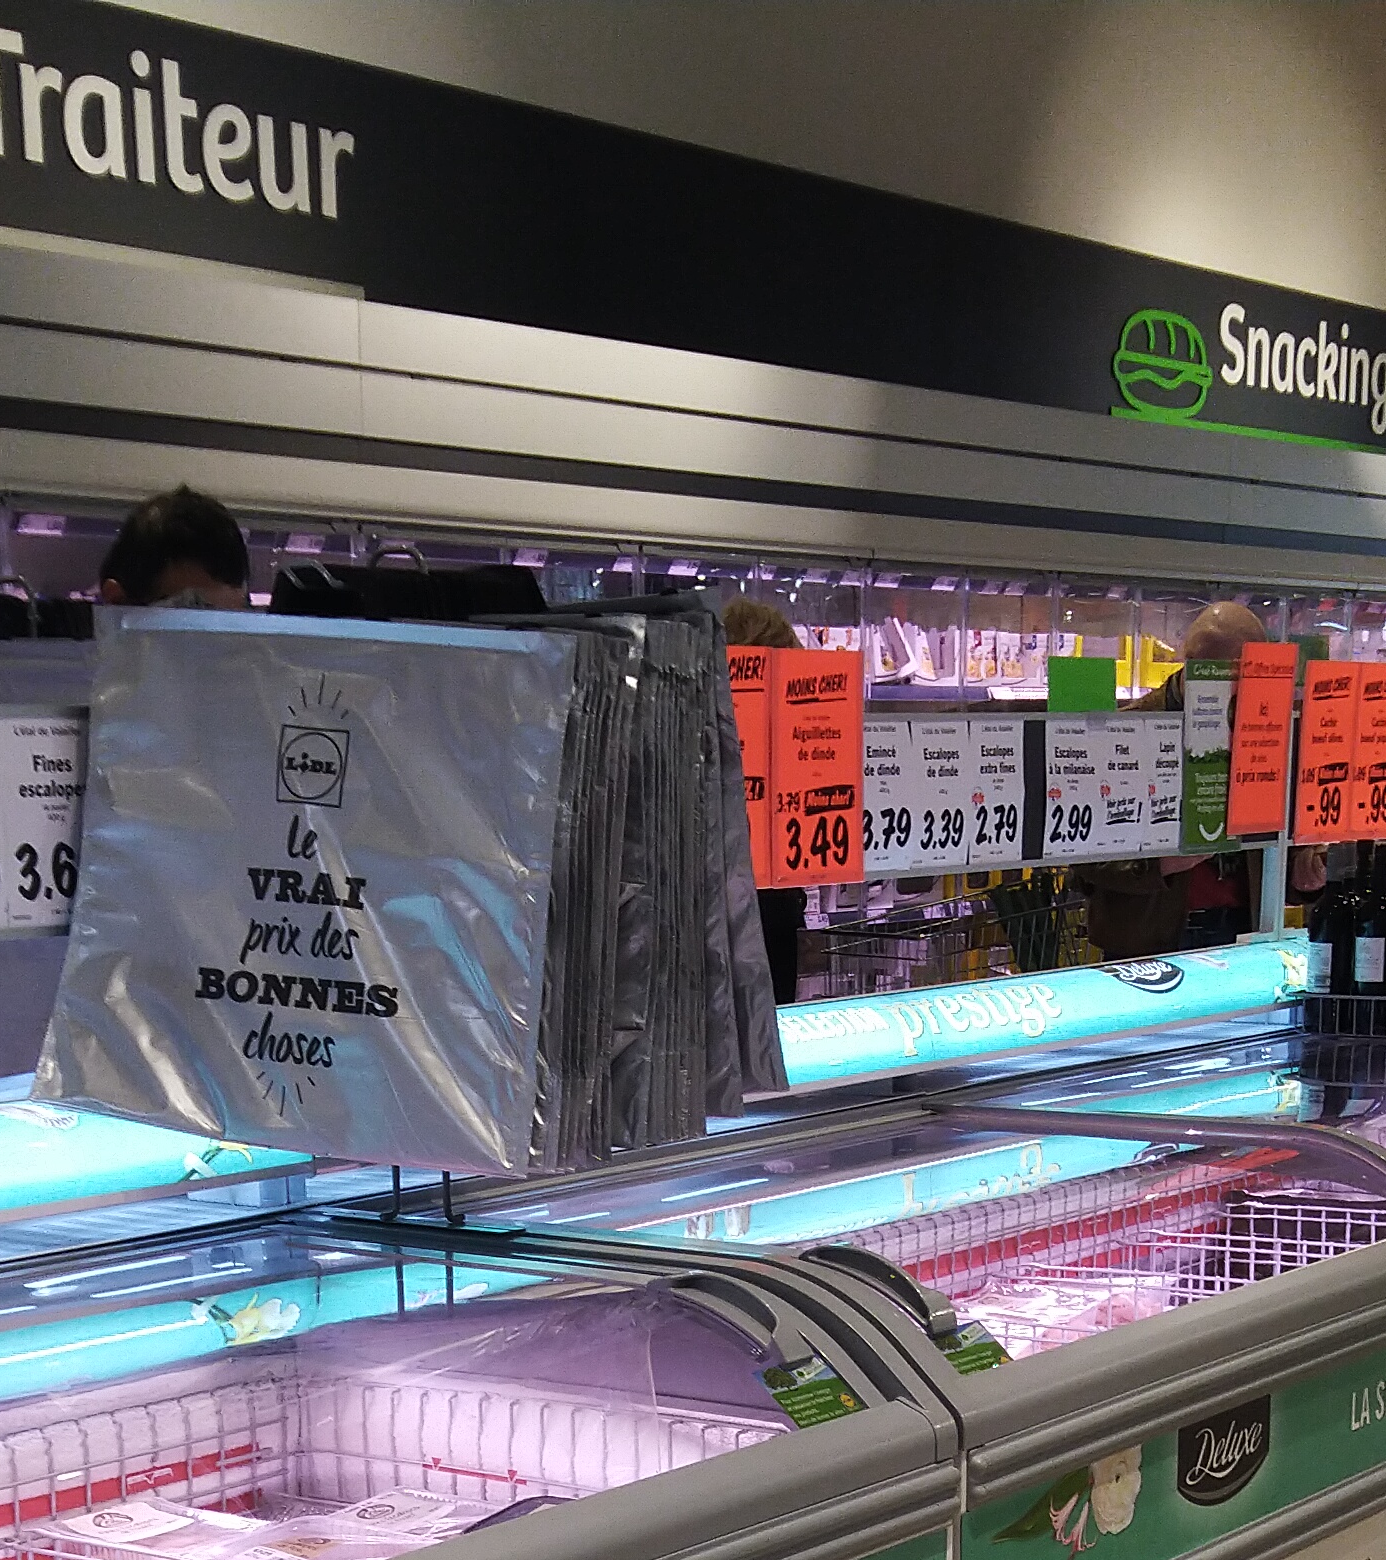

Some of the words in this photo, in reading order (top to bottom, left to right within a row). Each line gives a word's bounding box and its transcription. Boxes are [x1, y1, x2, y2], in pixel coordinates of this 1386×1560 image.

[792, 726, 842, 743] Aiguillettes
[923, 747, 960, 763] Escalopes
[981, 745, 1014, 760] Escalopes
[32, 754, 73, 773] Fines
[863, 763, 874, 776] de
[927, 766, 936, 777] de
[18, 779, 86, 800] escalope
[786, 815, 849, 871] 3.49
[863, 806, 912, 851] 3.79
[920, 808, 964, 850] 3.39
[975, 803, 1018, 846] 2.79
[1049, 804, 1093, 844] 2.99
[14, 841, 79, 903] 3.6
[247, 867, 369, 911] VRAI
[239, 918, 303, 964] prix
[310, 912, 360, 962] des
[194, 965, 400, 1019] BONNES
[241, 1011, 337, 1068] choses
[882, 982, 1063, 1058] prestige
[1350, 1386, 1371, 1432] LA
[1185, 1419, 1263, 1486] Deluxe
